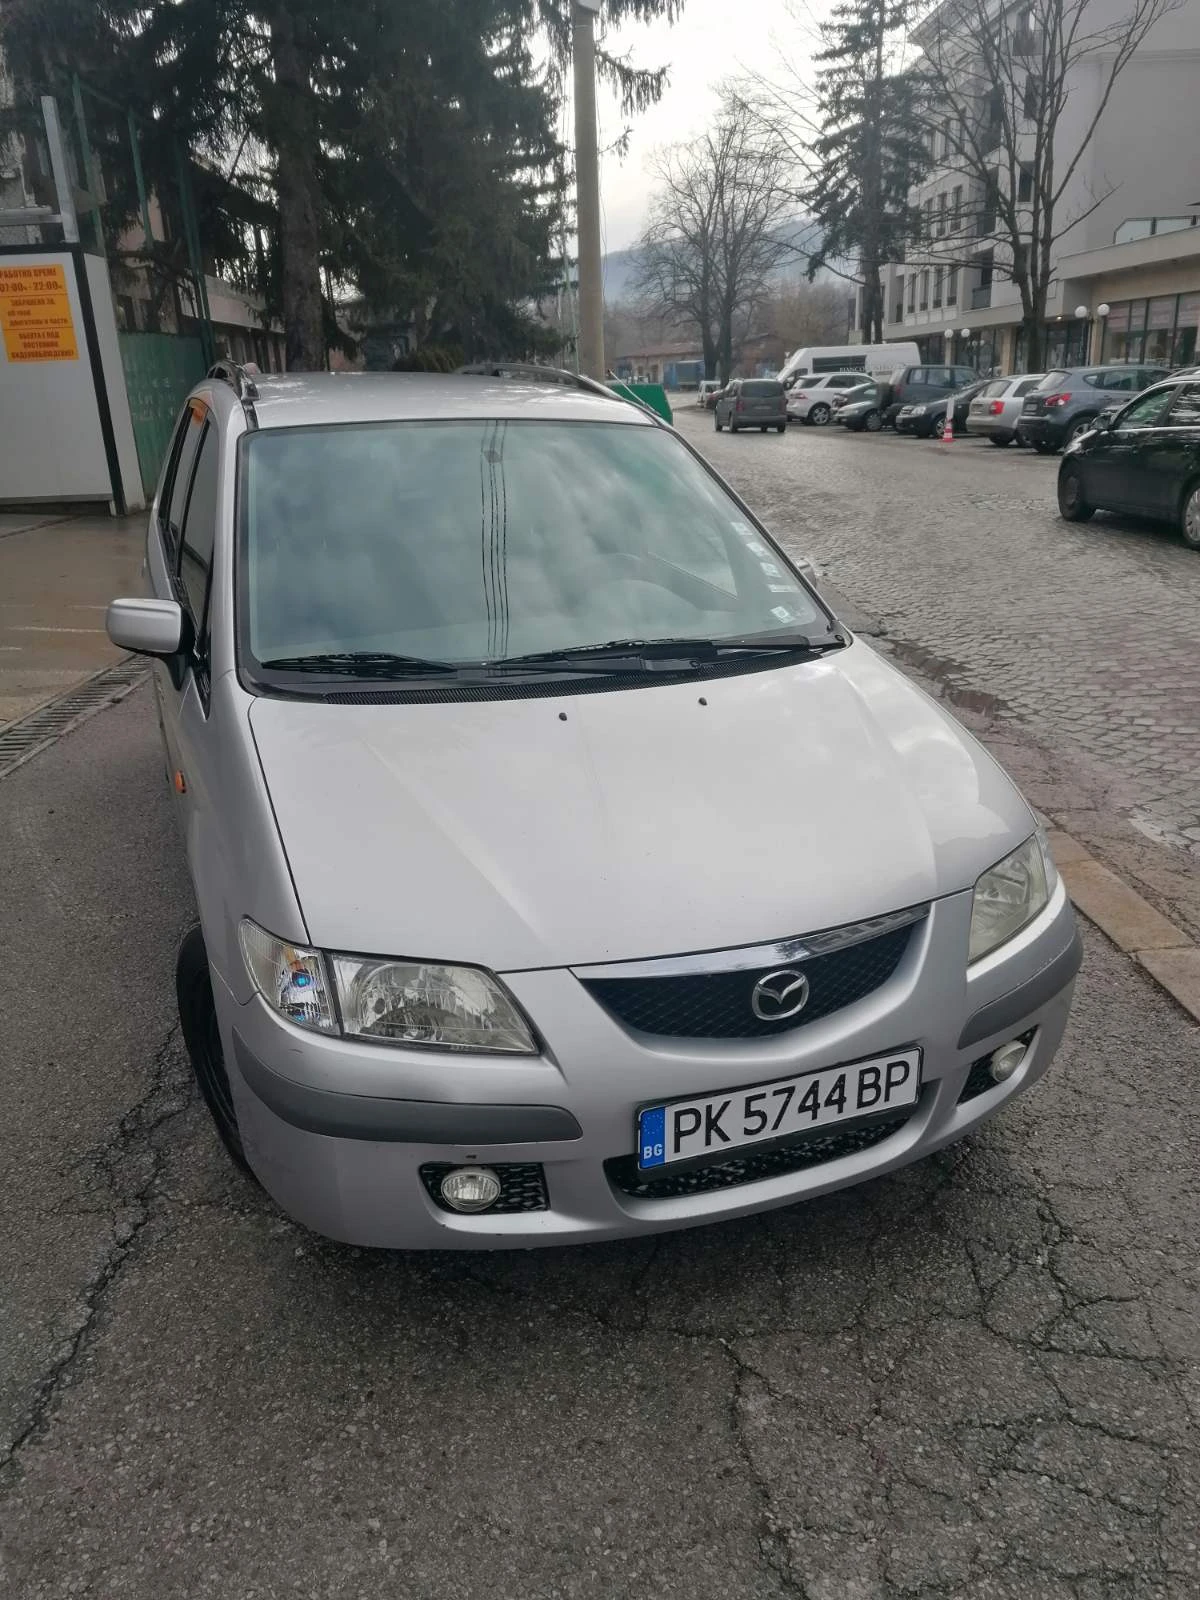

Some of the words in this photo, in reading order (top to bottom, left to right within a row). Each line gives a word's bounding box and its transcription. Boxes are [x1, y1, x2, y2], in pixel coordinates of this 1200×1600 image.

[673, 1100, 732, 1154] PK
[743, 1073, 848, 1136] 5744
[856, 1060, 910, 1109] BP
[643, 1143, 663, 1160] BG
